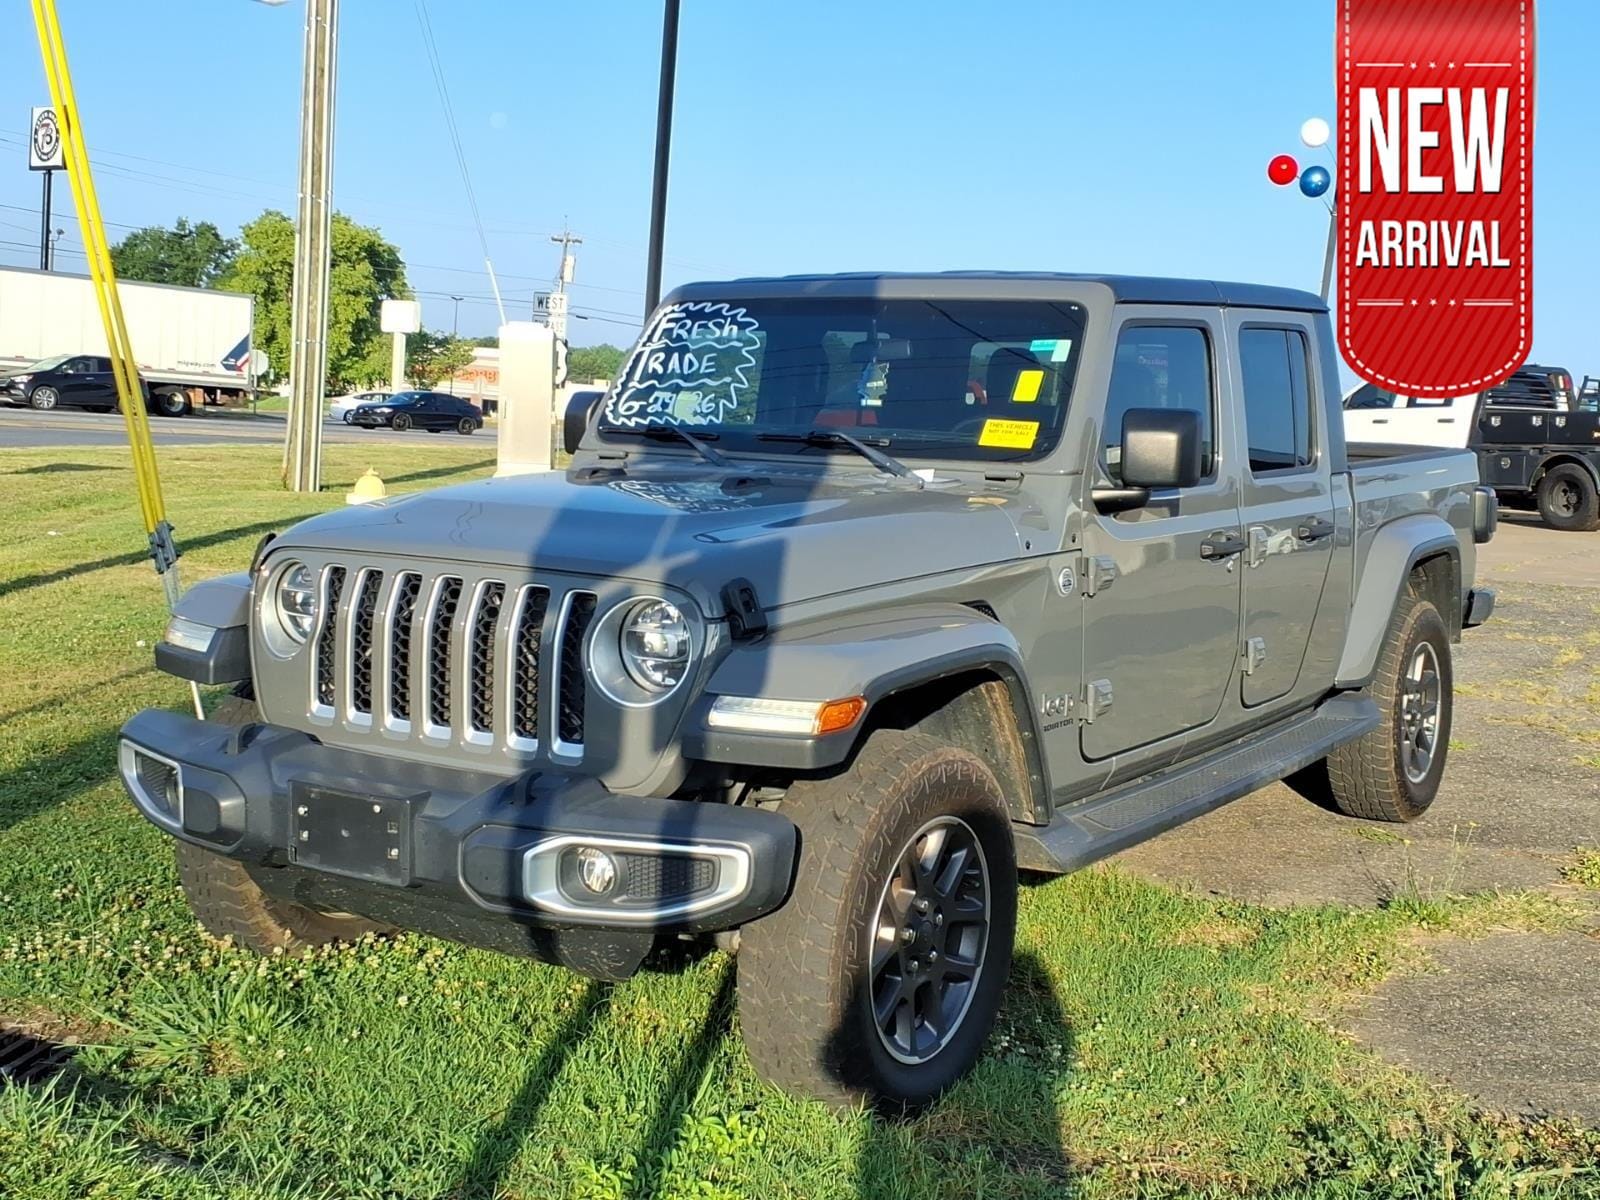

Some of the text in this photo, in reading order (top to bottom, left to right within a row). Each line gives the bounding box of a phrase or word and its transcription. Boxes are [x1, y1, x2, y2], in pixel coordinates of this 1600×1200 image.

[537, 296, 564, 310] WEST
[633, 343, 718, 382] TRADE
[1041, 693, 1074, 717] Jeep
